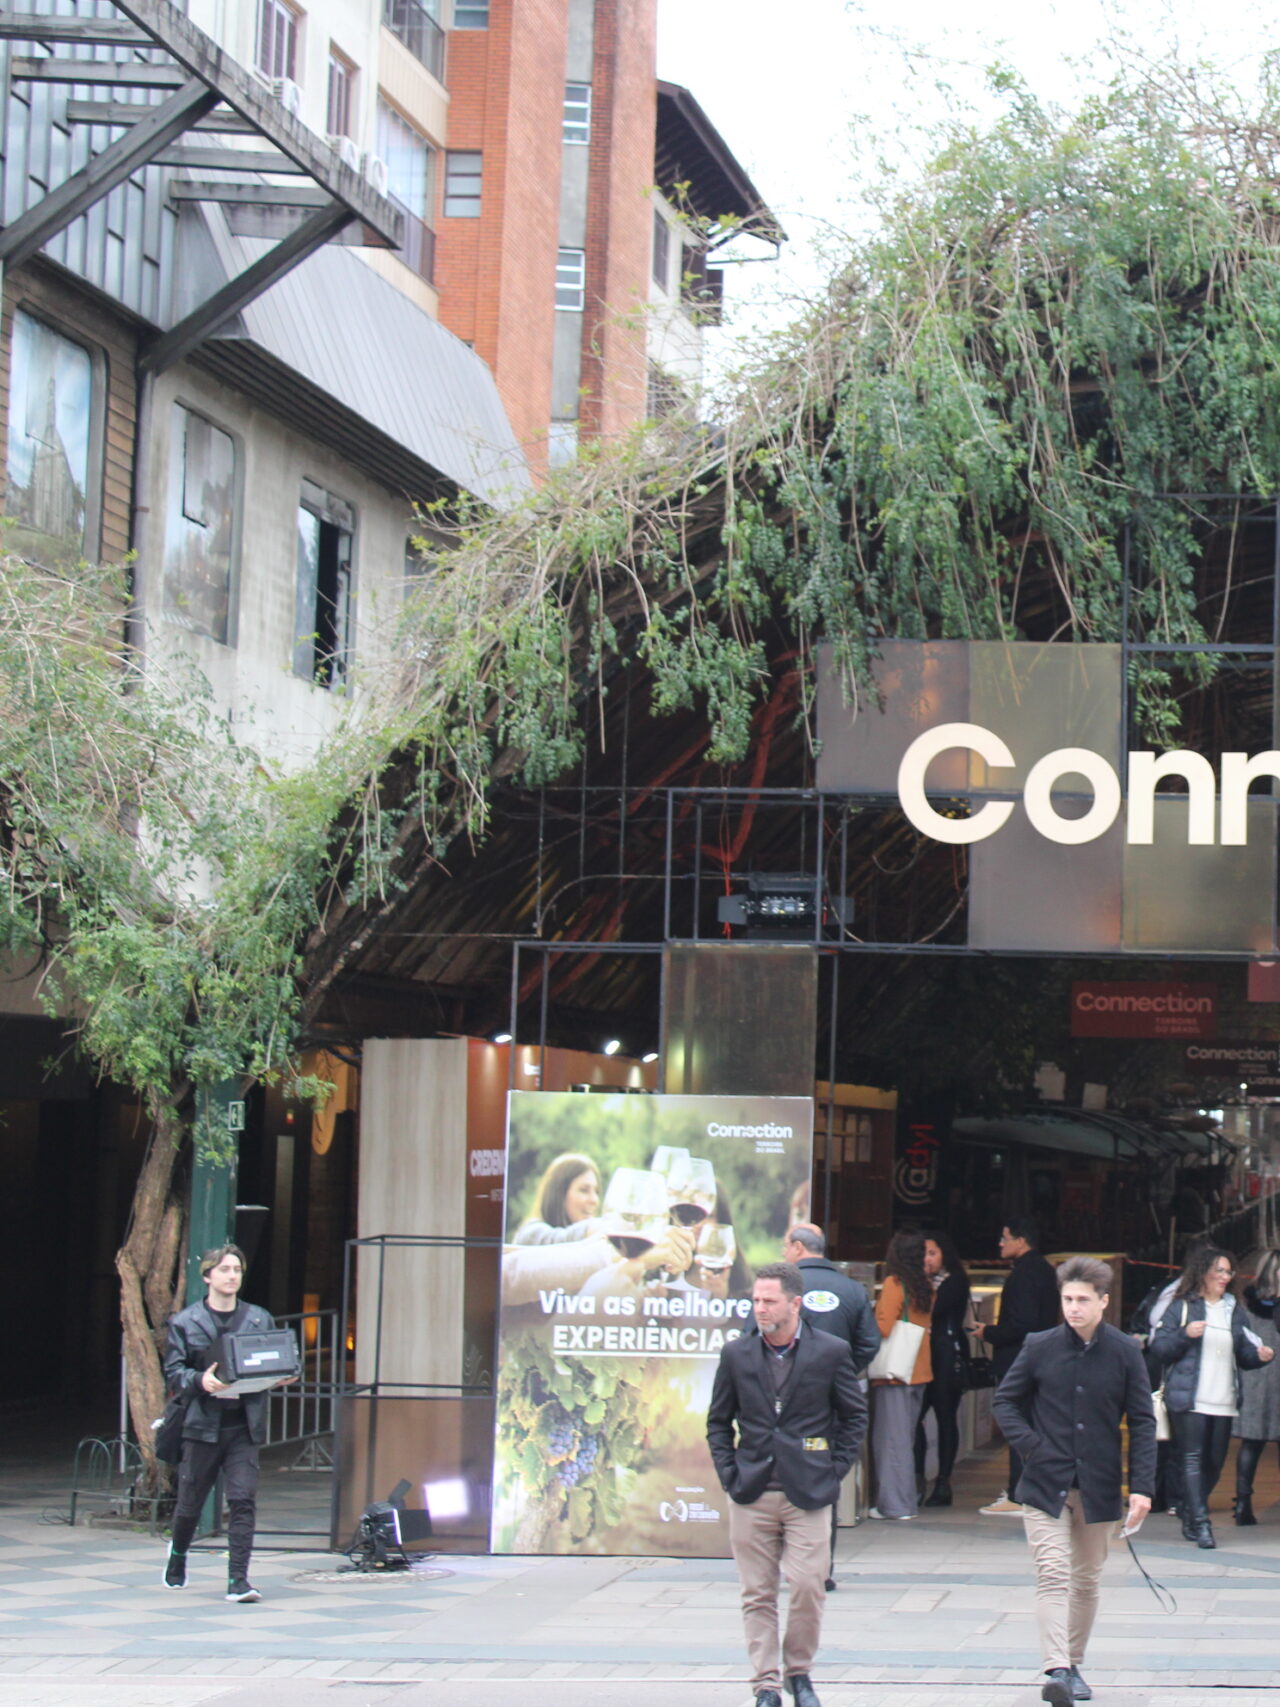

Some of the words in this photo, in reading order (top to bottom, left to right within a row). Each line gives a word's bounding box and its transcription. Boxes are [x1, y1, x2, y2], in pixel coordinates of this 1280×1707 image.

[1075, 991, 1212, 1014] Connection
[1186, 1046, 1278, 1061] Connection
[707, 1122, 793, 1138] Connection
[539, 1287, 596, 1314] Viva
[603, 1296, 637, 1316] as
[643, 1291, 752, 1318] melhore
[553, 1318, 743, 1351] EXPERIÊNCIAS
